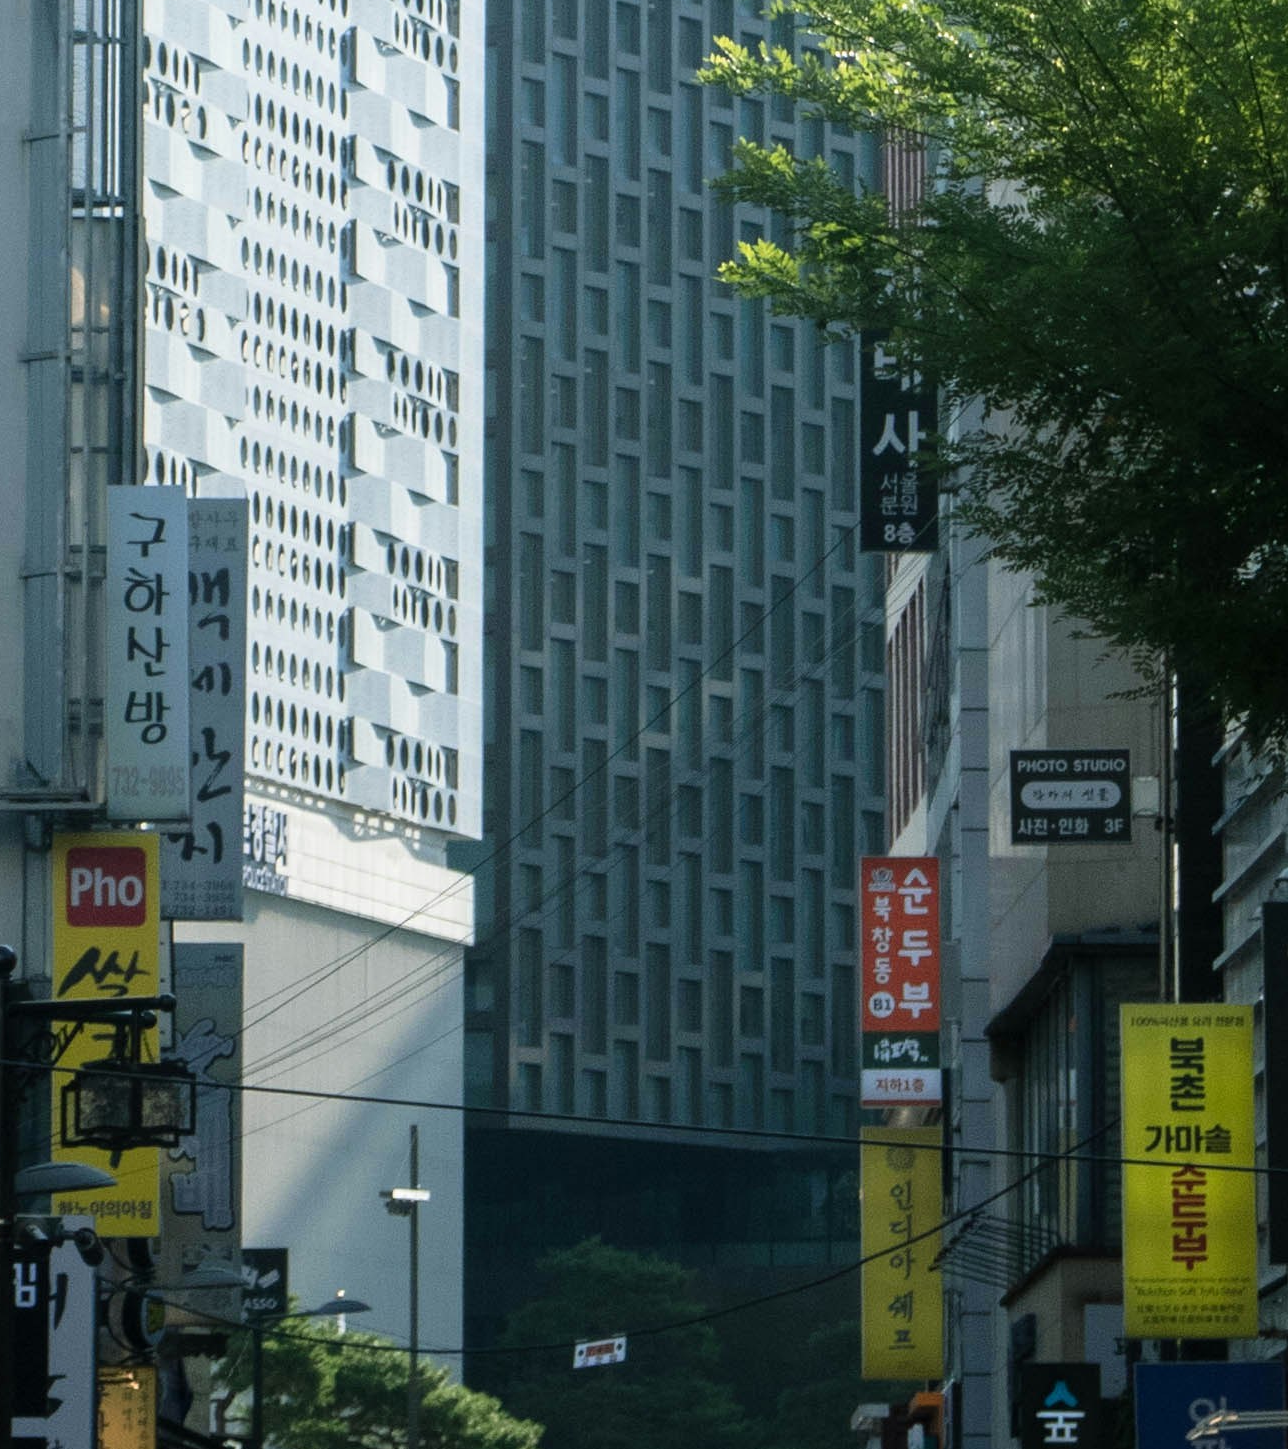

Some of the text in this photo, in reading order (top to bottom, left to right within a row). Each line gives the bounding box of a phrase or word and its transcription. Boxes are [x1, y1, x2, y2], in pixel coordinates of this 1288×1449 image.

[124, 512, 170, 745] 구하산방
[1017, 758, 1126, 773] PHOTO STUDIO
[1104, 818, 1124, 833] 3F
[69, 866, 144, 907] Pho
[871, 896, 893, 984] 북창동
[898, 867, 932, 1019] 순두부
[873, 998, 892, 1012] B1
[1170, 1037, 1206, 1112] 북촌
[57, 1198, 154, 1220] 하노이의아침
[1171, 1164, 1208, 1272] 순두부
